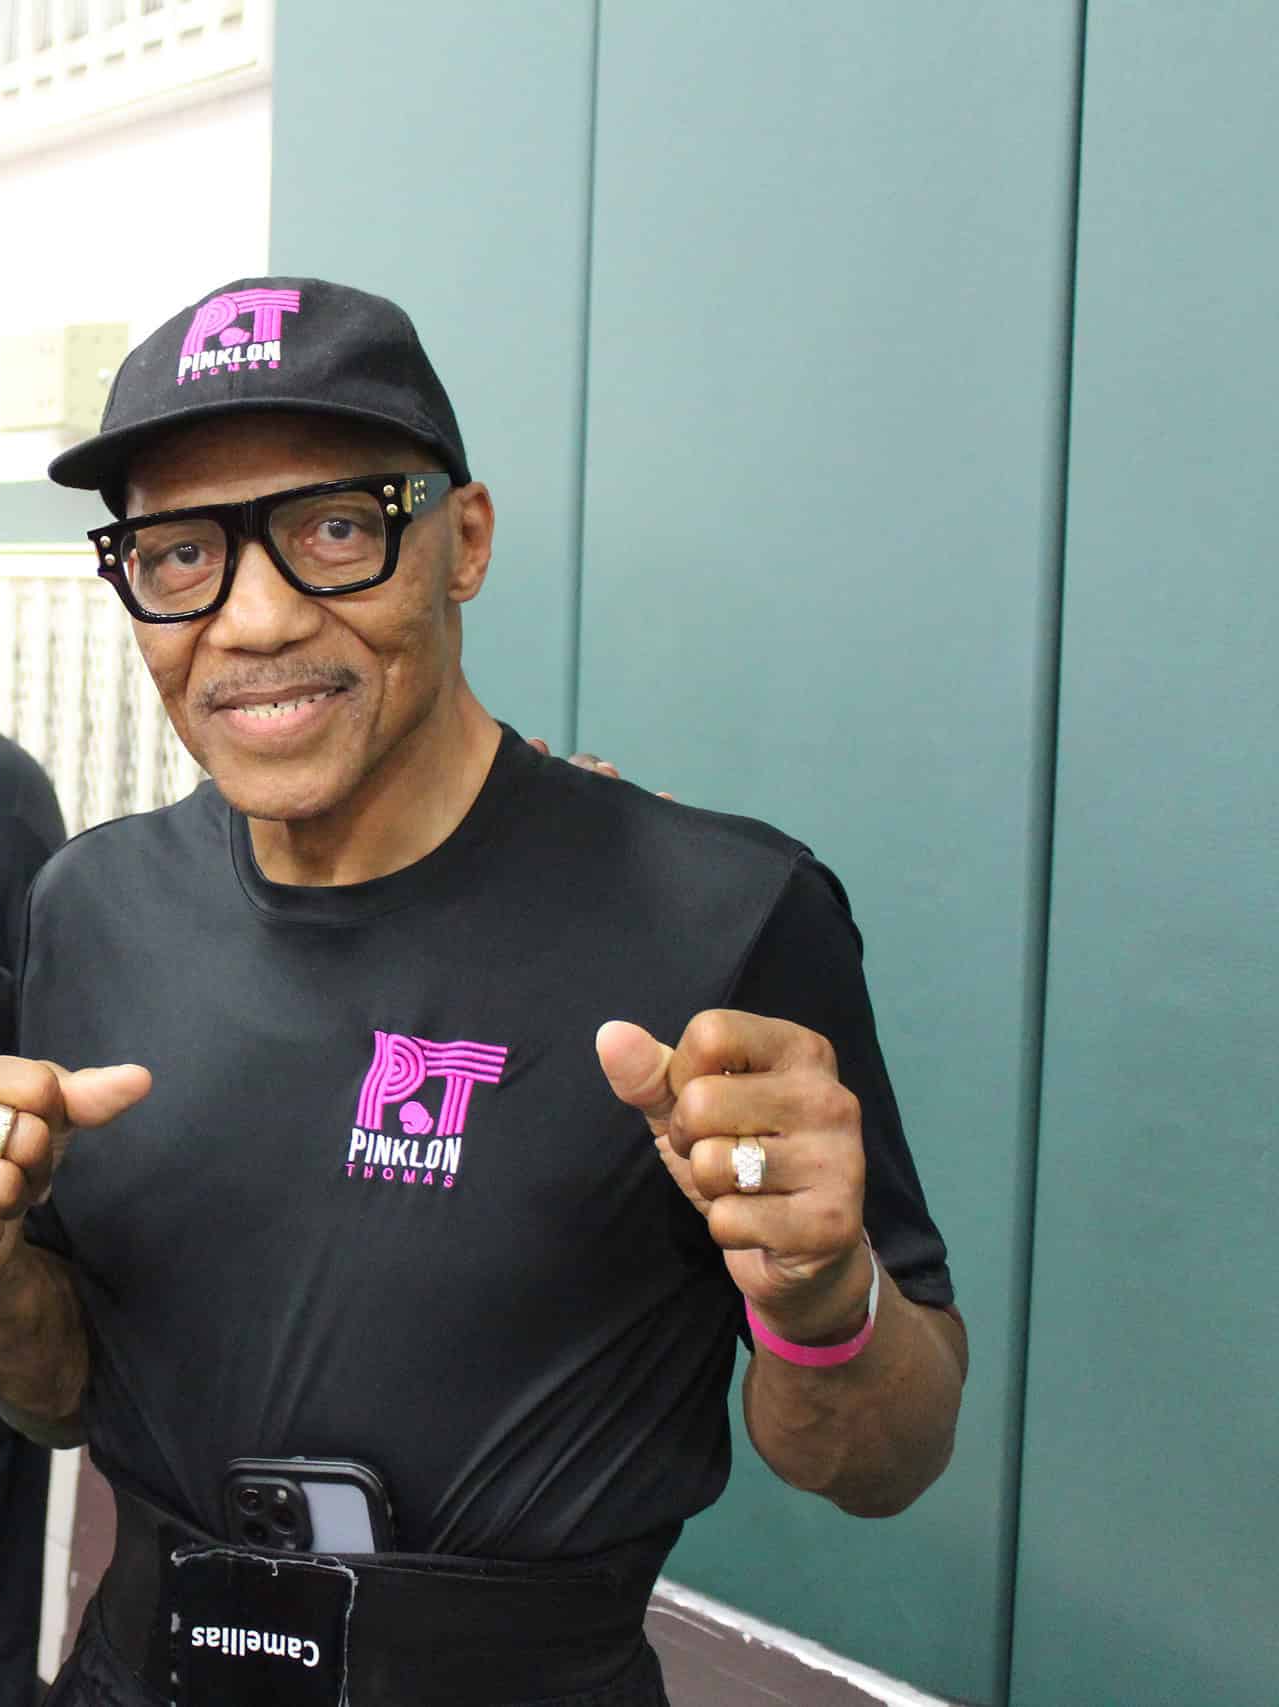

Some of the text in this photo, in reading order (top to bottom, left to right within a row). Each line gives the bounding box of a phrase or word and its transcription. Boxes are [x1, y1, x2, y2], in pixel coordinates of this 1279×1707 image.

[176, 361, 280, 386] THOMAS
[178, 341, 281, 377] PINKLON
[348, 1127, 462, 1174] PINKLON
[344, 1163, 456, 1188] THOMAS
[191, 1626, 320, 1668] Camellias
